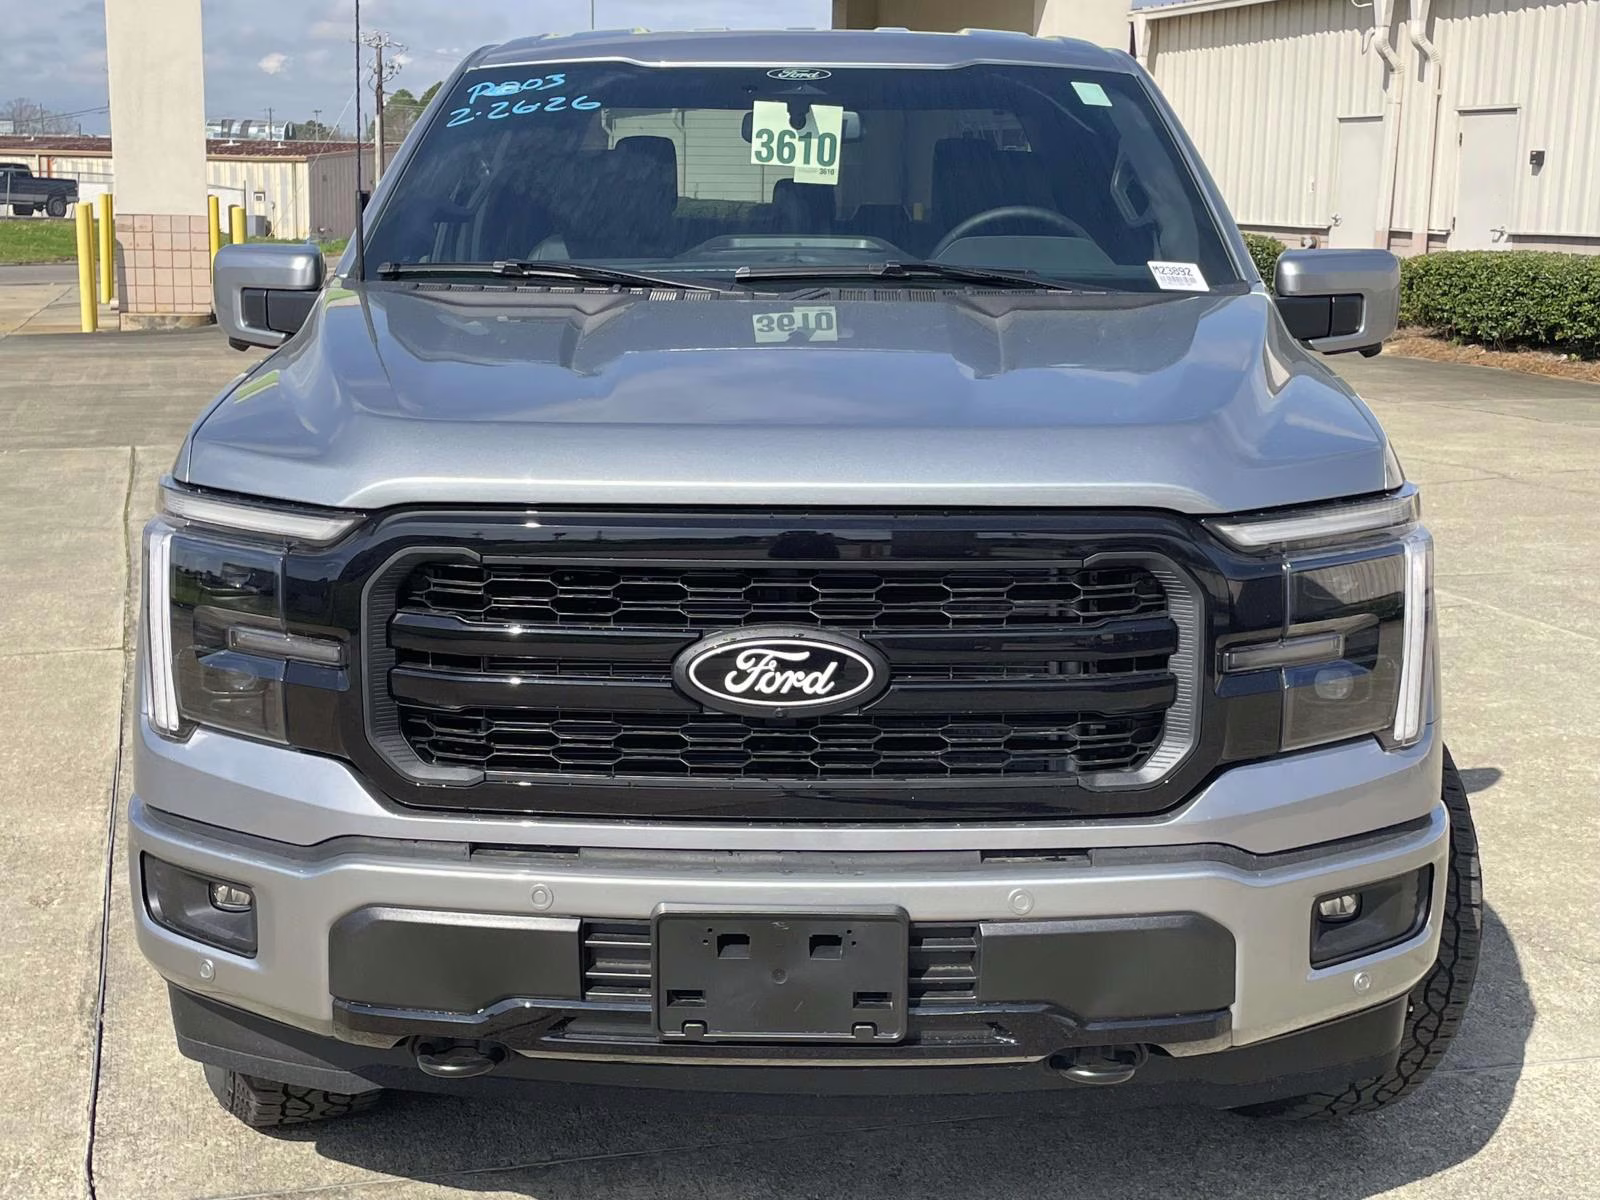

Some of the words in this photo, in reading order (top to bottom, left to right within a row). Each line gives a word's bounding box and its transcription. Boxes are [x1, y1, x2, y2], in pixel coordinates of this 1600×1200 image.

[778, 69, 820, 79] Ford
[754, 128, 838, 167] 3610
[724, 648, 839, 695] Ford
